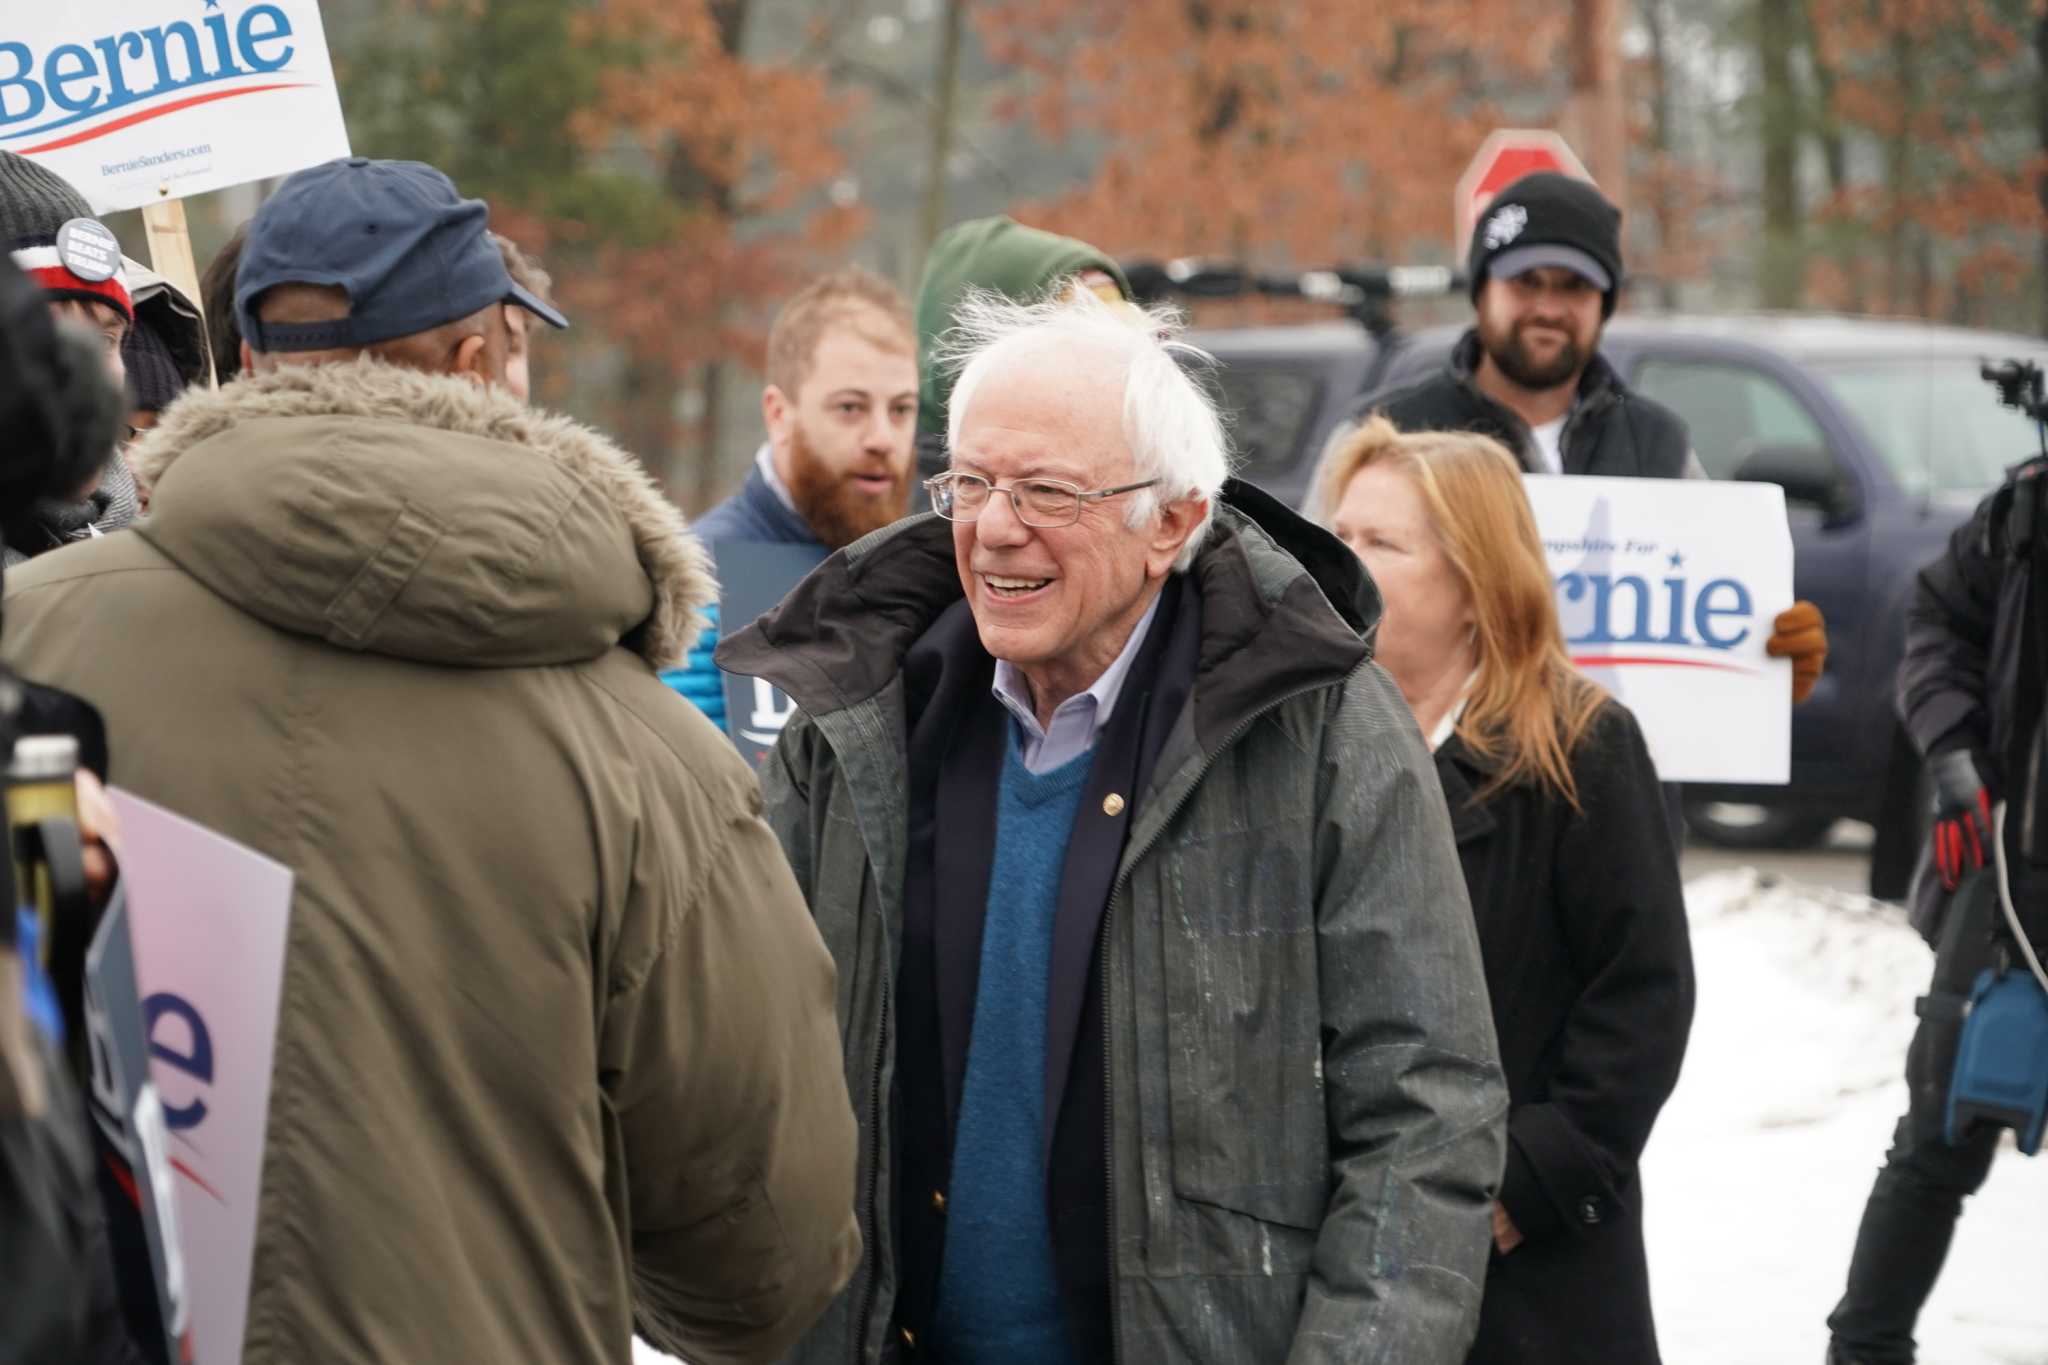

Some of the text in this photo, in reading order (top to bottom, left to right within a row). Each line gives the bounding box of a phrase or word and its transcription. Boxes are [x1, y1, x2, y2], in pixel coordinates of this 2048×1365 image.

[0, 0, 294, 126] Bernie
[101, 143, 212, 176] BernieSanders.com
[1624, 539, 1659, 553] For
